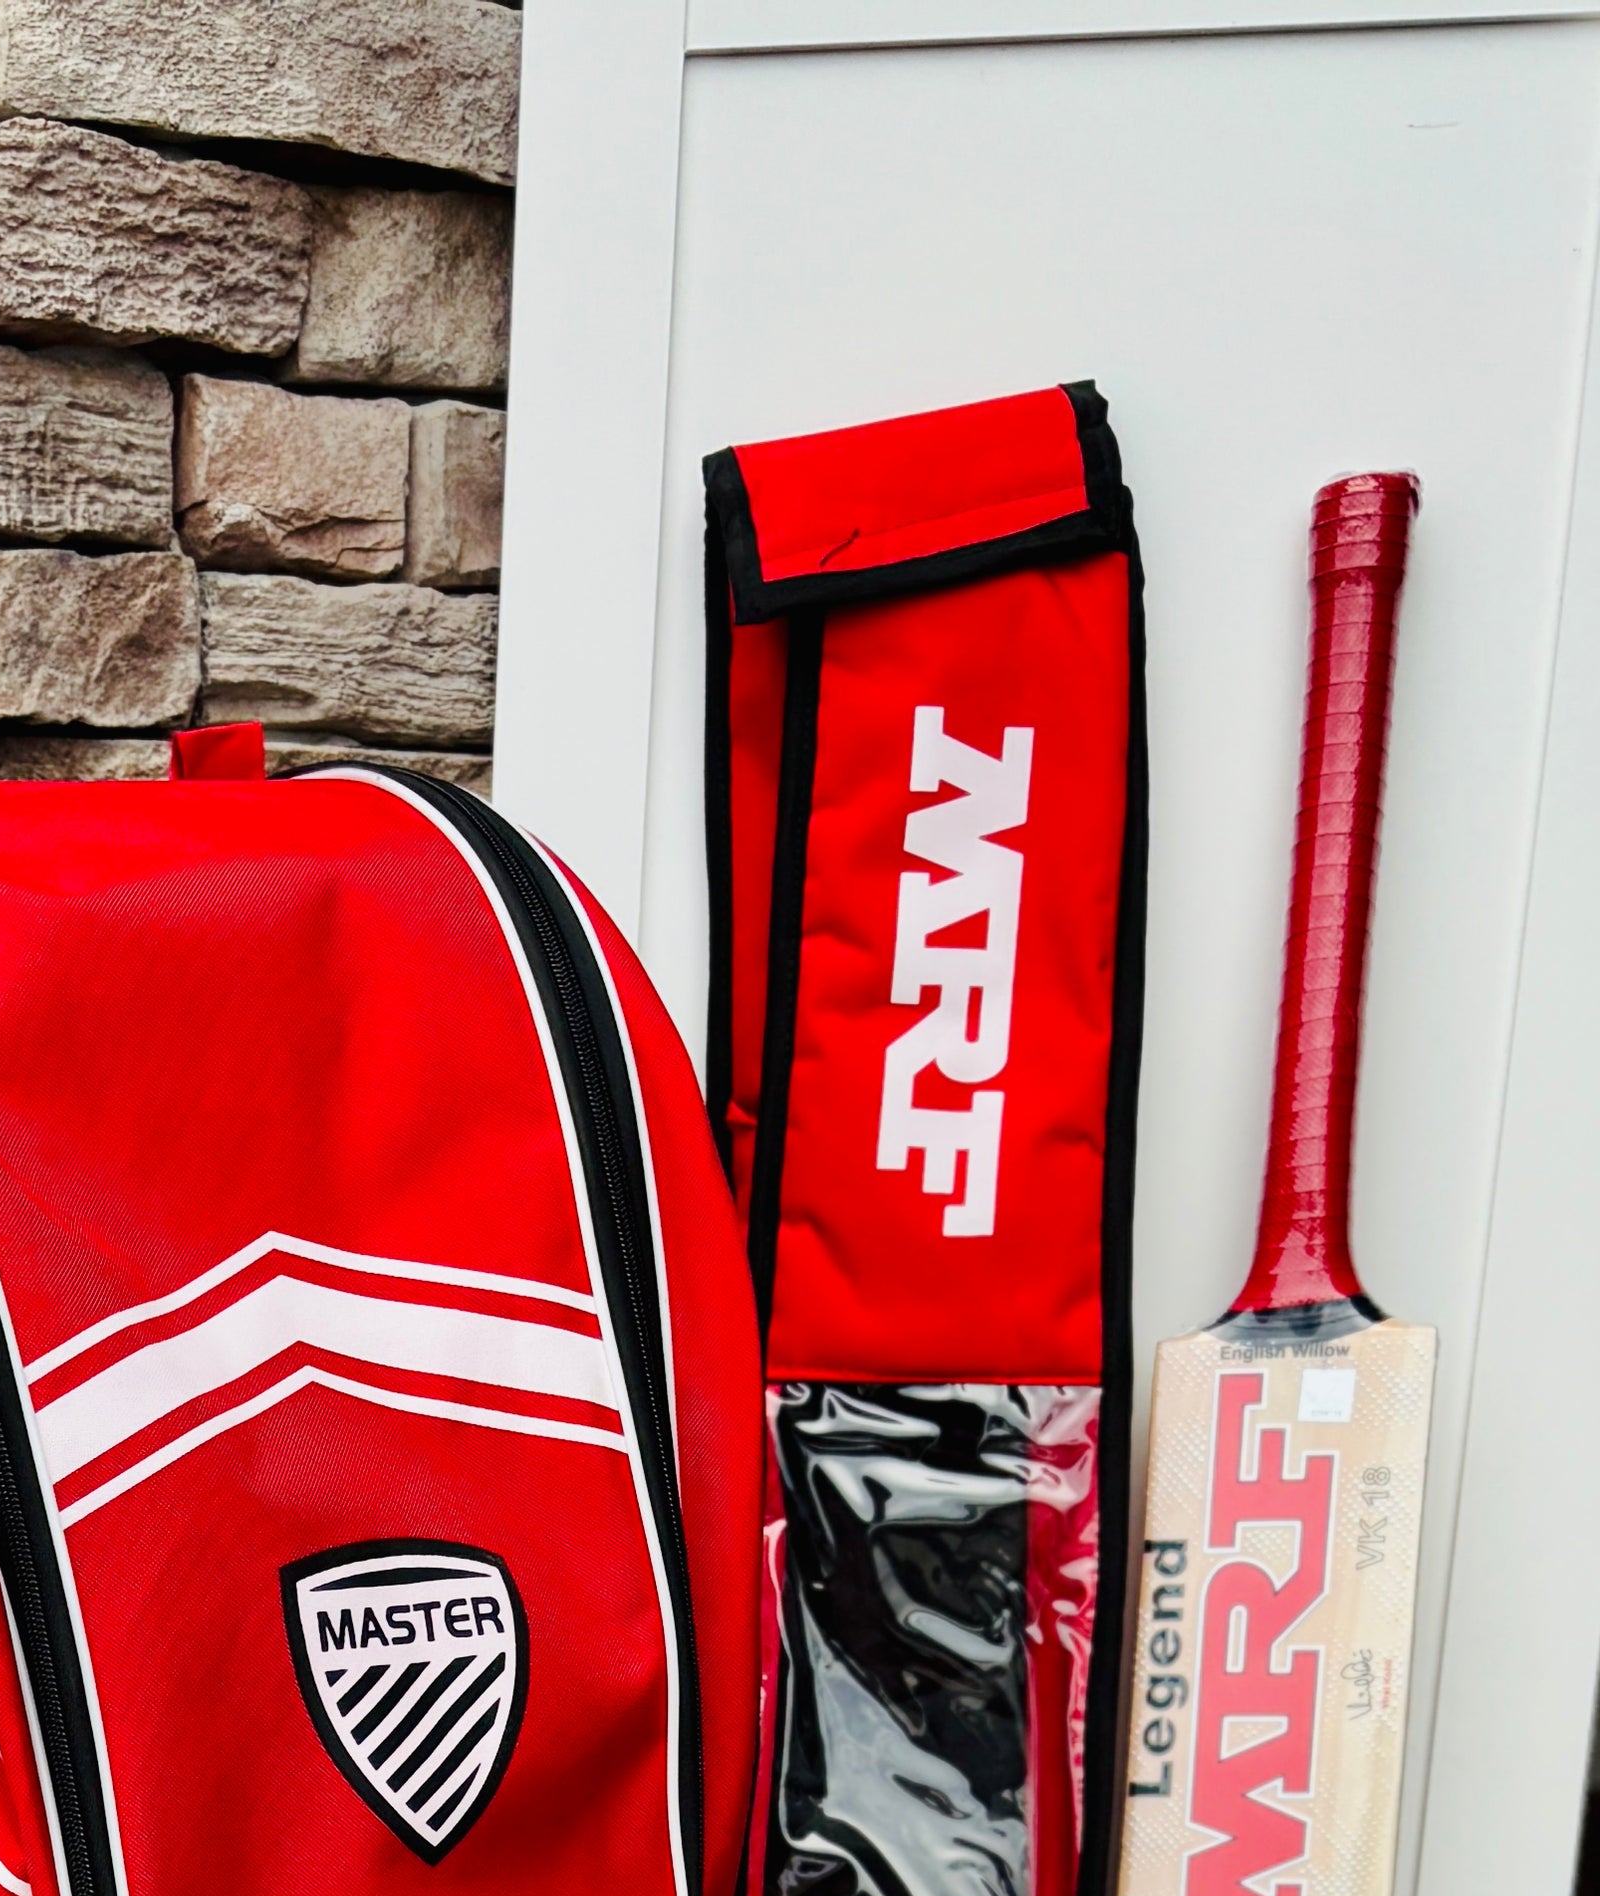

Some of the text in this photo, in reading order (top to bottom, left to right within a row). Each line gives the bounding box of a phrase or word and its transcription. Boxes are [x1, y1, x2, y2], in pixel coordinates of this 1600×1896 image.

[876, 706, 1035, 1237] MRF
[1219, 1344, 1351, 1363] English Willow
[1356, 1466, 1391, 1570] VK 18
[317, 1596, 505, 1652] MASTER
[1129, 1538, 1188, 1800] Legend
